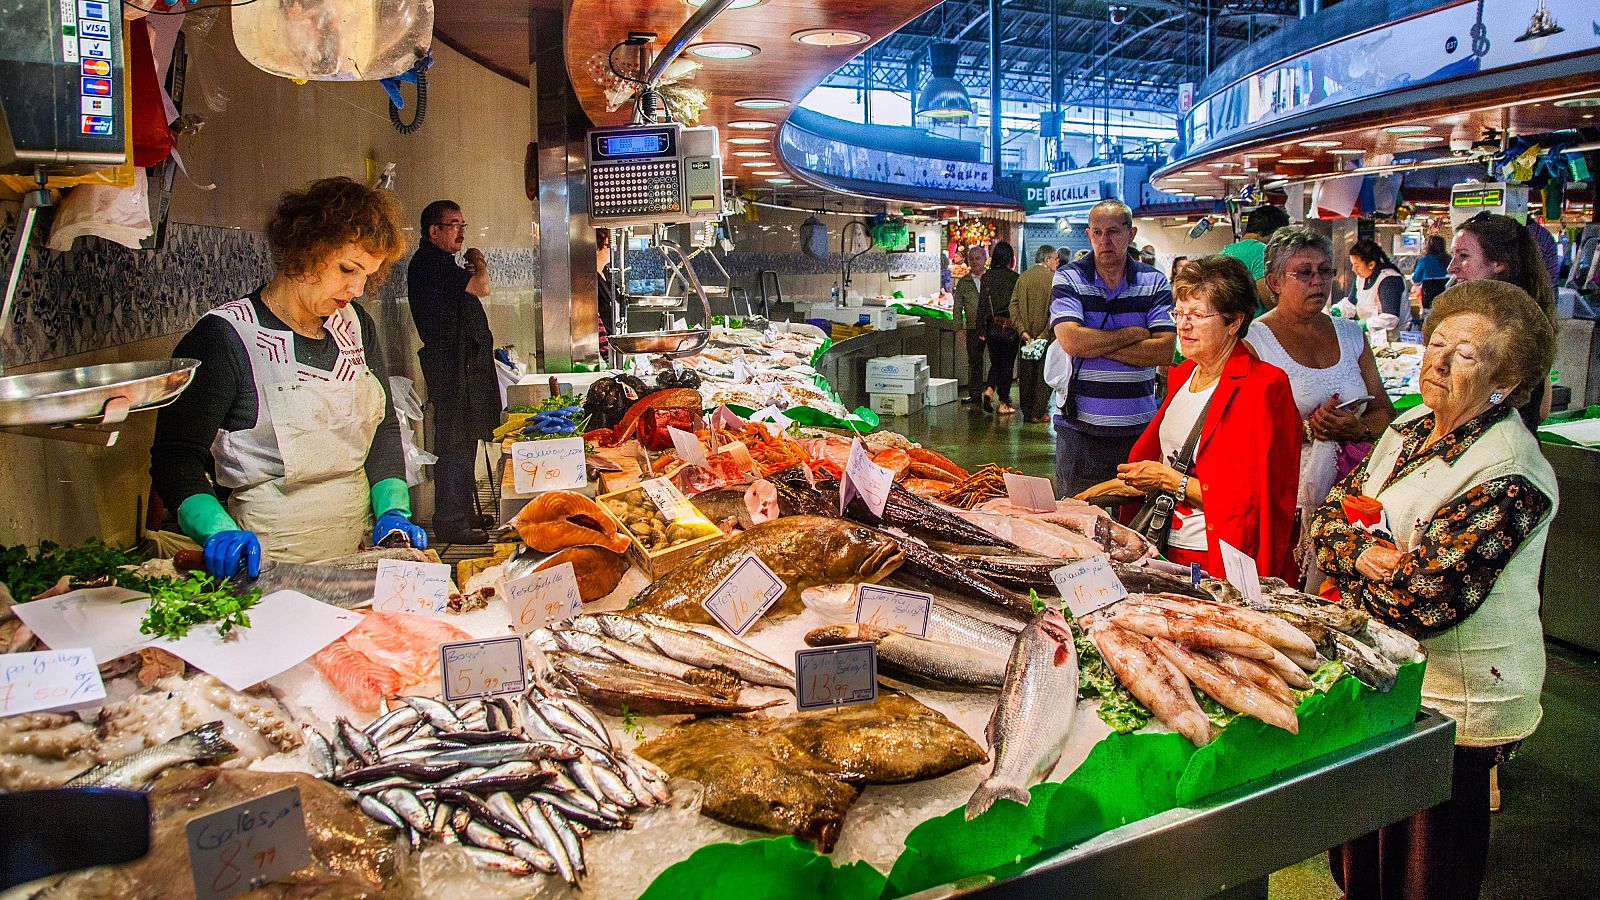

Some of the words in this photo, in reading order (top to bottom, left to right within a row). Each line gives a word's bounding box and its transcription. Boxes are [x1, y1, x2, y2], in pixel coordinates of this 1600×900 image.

[86, 24, 107, 32] VISA
[944, 163, 989, 182] Laura
[1050, 186, 1089, 202] BACALLA
[520, 461, 561, 488] 9'50
[520, 590, 562, 625] 6'99
[455, 665, 499, 696] 5'99
[807, 673, 849, 701] 13'99
[212, 835, 276, 893] 8'99
